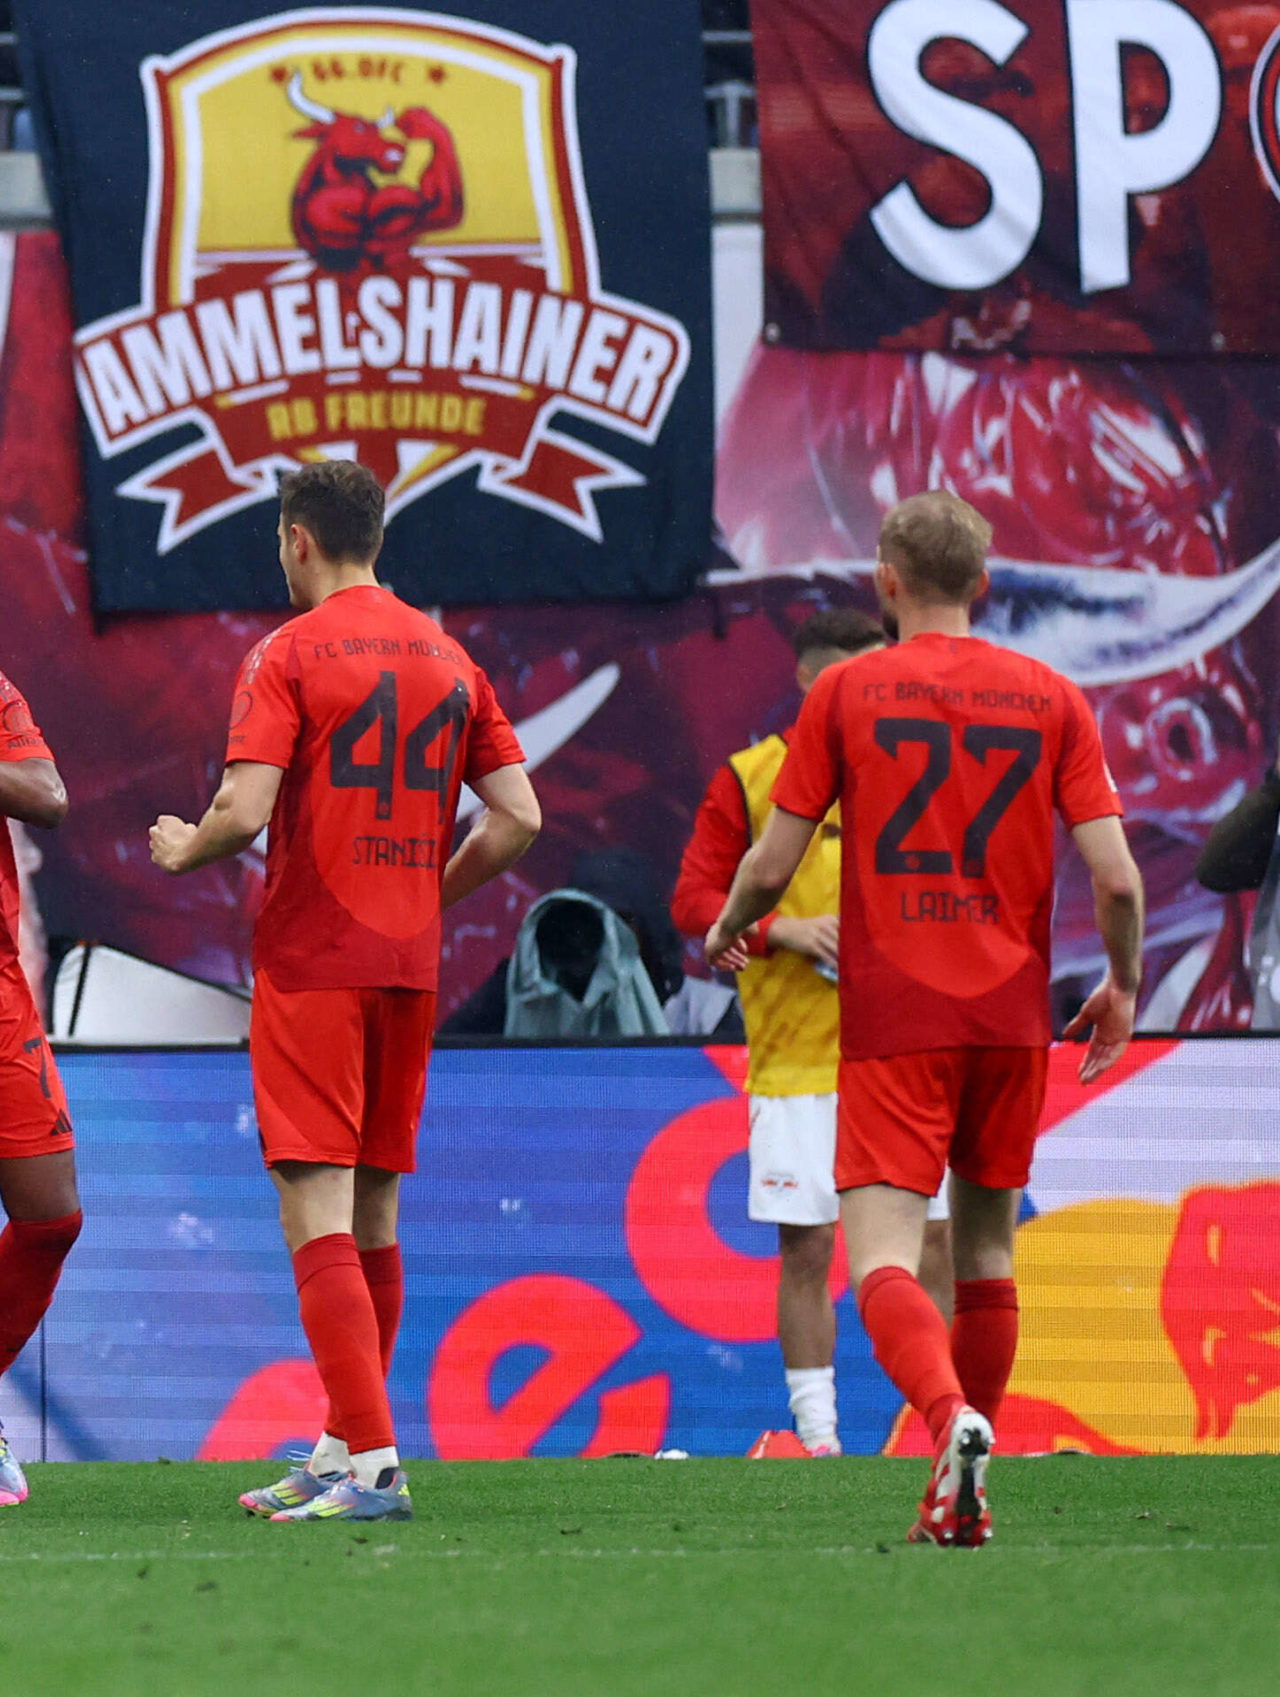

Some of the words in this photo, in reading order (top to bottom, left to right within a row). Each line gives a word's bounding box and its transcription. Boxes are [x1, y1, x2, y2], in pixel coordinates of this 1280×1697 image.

[81, 274, 673, 435] AMMELSHAINER
[266, 397, 318, 441] RB
[324, 390, 487, 436] FREUNDE
[313, 643, 337, 660] FC
[342, 638, 401, 657] BAYERN
[863, 684, 886, 702] FC
[894, 681, 964, 706] BAYERN
[329, 670, 470, 826] 44
[873, 717, 1043, 879] 27
[900, 891, 1000, 925] LAIMER
[23, 1036, 52, 1099] 7
